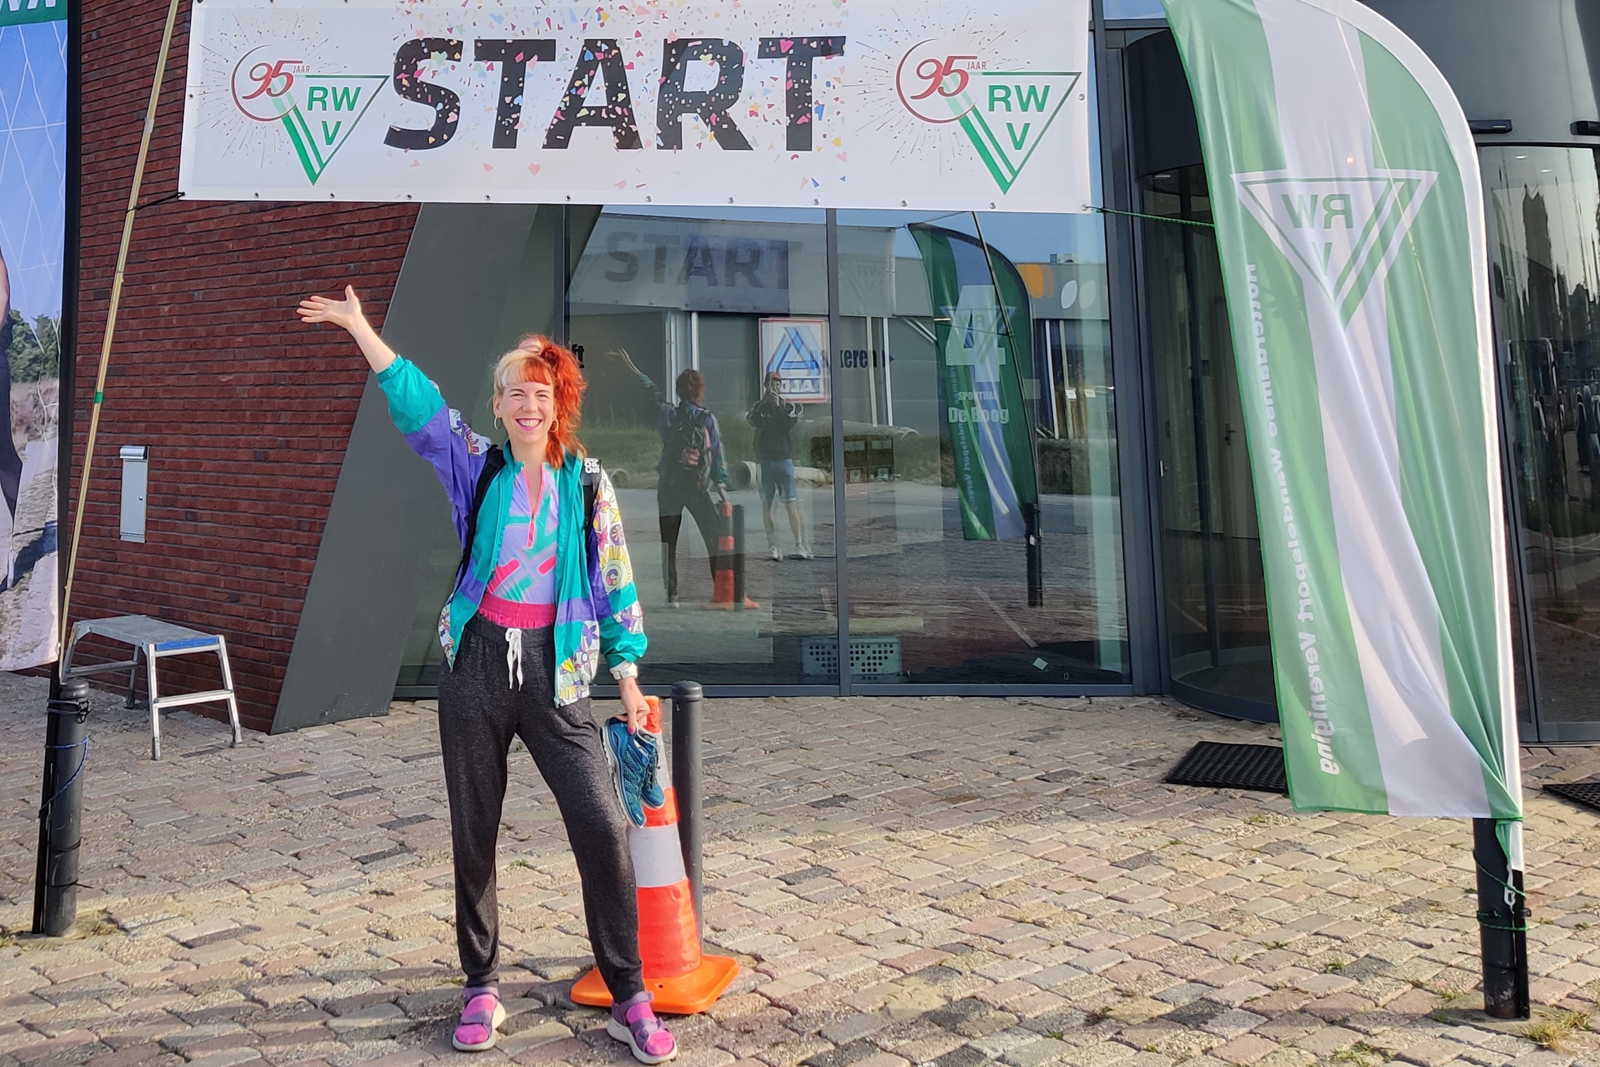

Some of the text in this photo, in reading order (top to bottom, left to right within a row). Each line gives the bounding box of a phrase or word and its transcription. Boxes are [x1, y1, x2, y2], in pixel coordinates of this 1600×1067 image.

[242, 60, 311, 99] 95 JAAR
[910, 56, 988, 99] 95 JAAR
[307, 86, 361, 111] RW
[383, 36, 846, 151] START
[988, 85, 1050, 112] RW
[321, 121, 342, 145] V
[1006, 122, 1031, 150] V
[605, 231, 803, 290] START
[948, 406, 967, 423] De
